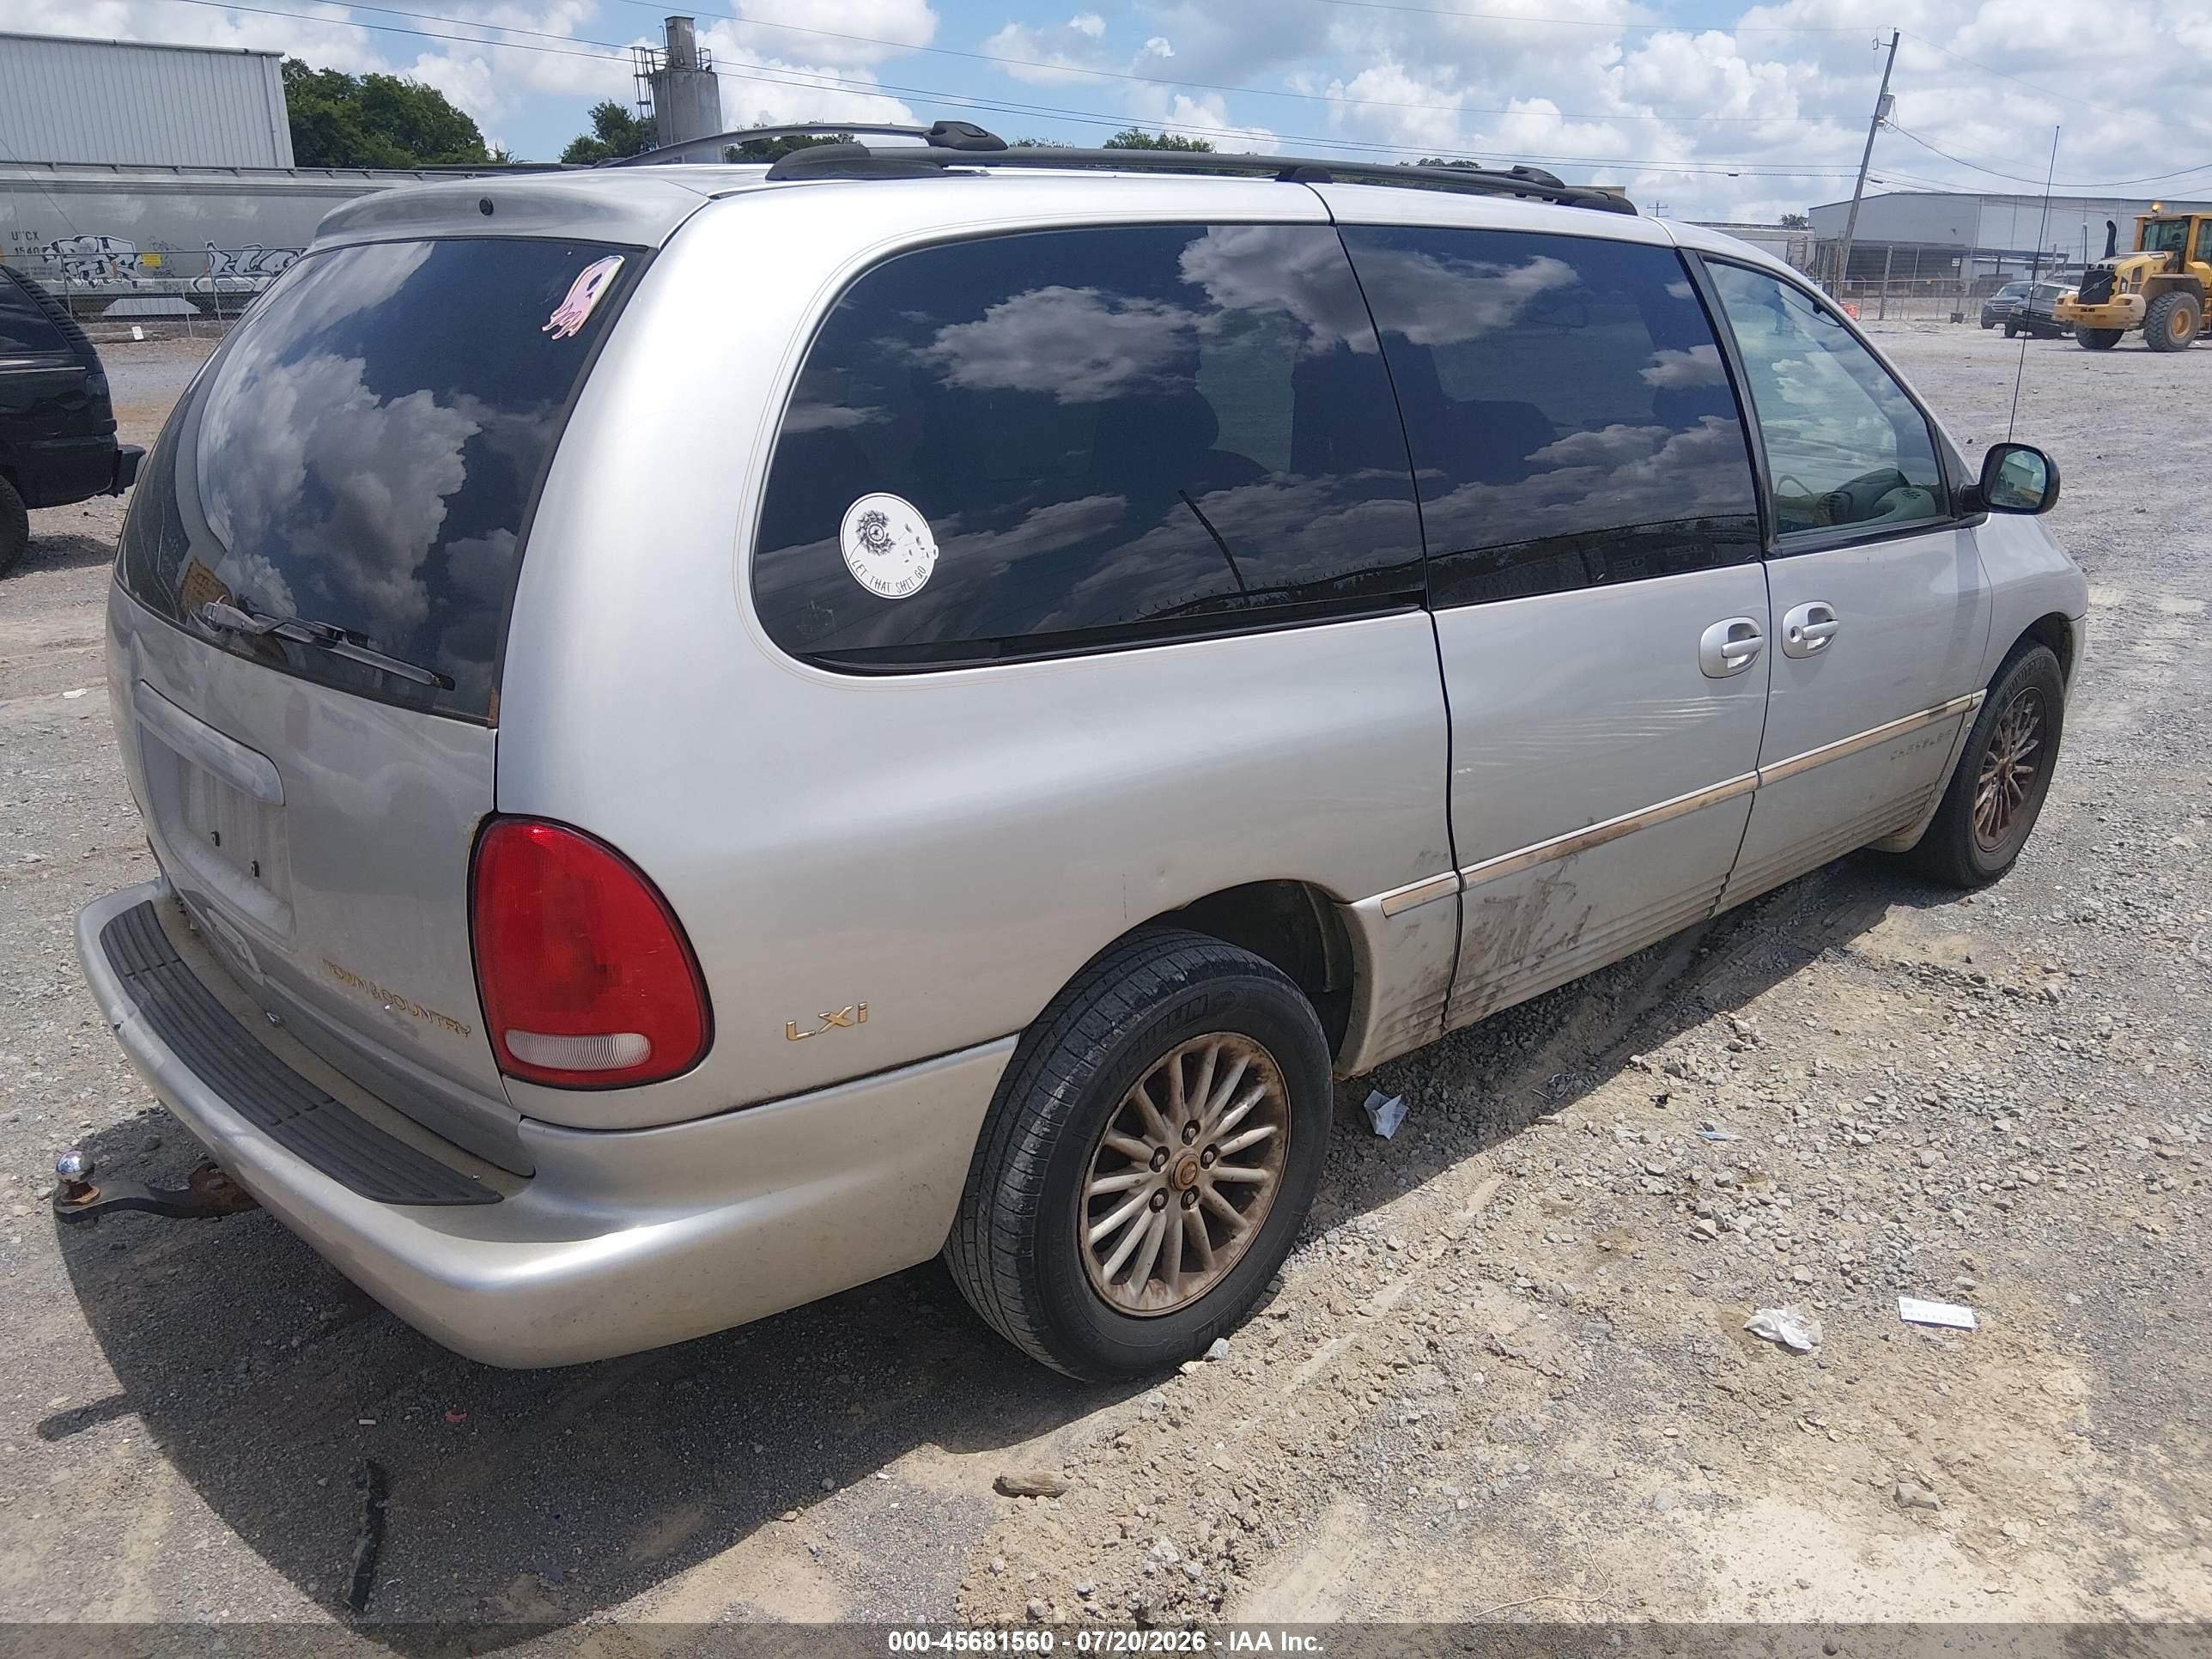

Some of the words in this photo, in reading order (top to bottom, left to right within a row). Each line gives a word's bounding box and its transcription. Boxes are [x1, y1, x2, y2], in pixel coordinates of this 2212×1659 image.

[11, 230, 40, 241] UCX
[851, 559, 868, 577] LET
[869, 576, 891, 593] THAT
[896, 576, 915, 593] SHIT
[914, 565, 927, 580] GO
